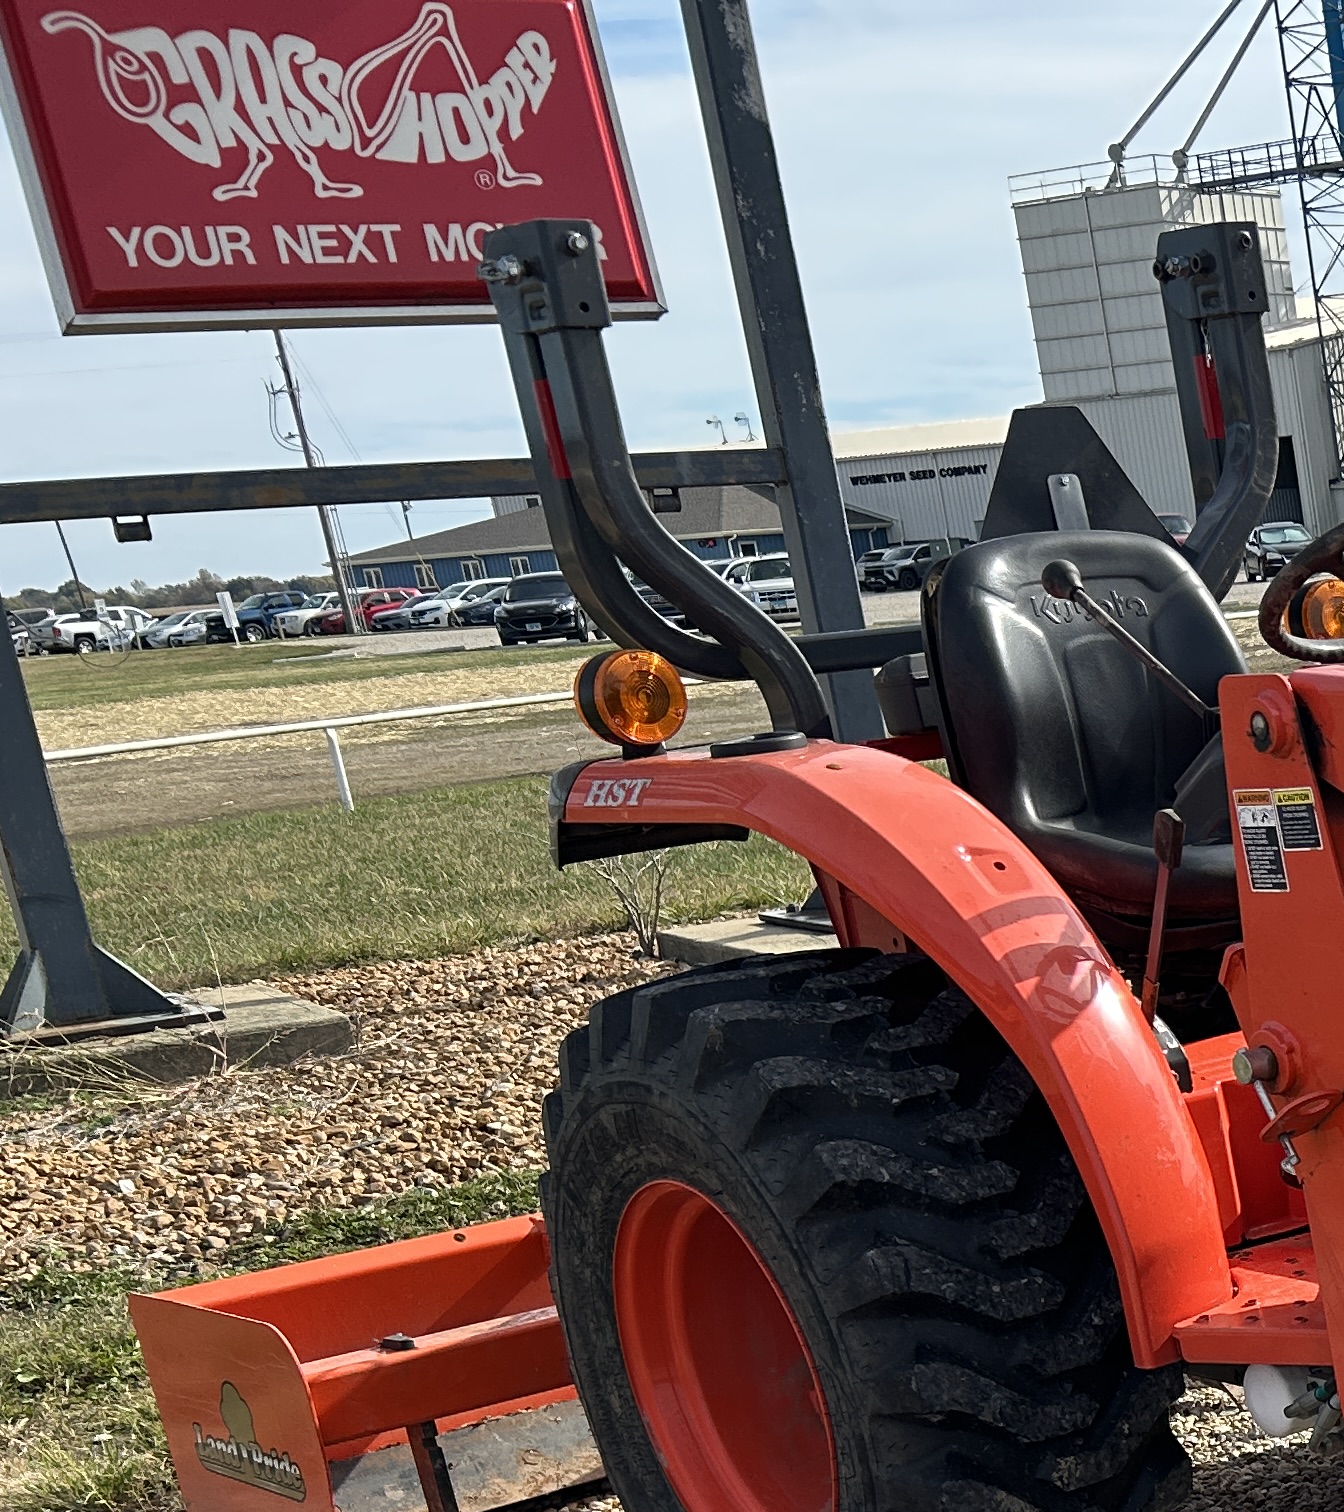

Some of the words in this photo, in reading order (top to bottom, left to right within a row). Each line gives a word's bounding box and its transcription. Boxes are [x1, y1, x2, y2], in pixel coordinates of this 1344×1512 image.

[106, 225, 257, 267] YOUR
[272, 223, 401, 264] NEXT
[850, 472, 906, 487] WEHMEYER
[909, 469, 936, 481] SEED
[939, 464, 988, 478] COMPANY
[583, 778, 653, 807] HST
[193, 1423, 242, 1469] Land
[250, 1441, 302, 1489] Pride
